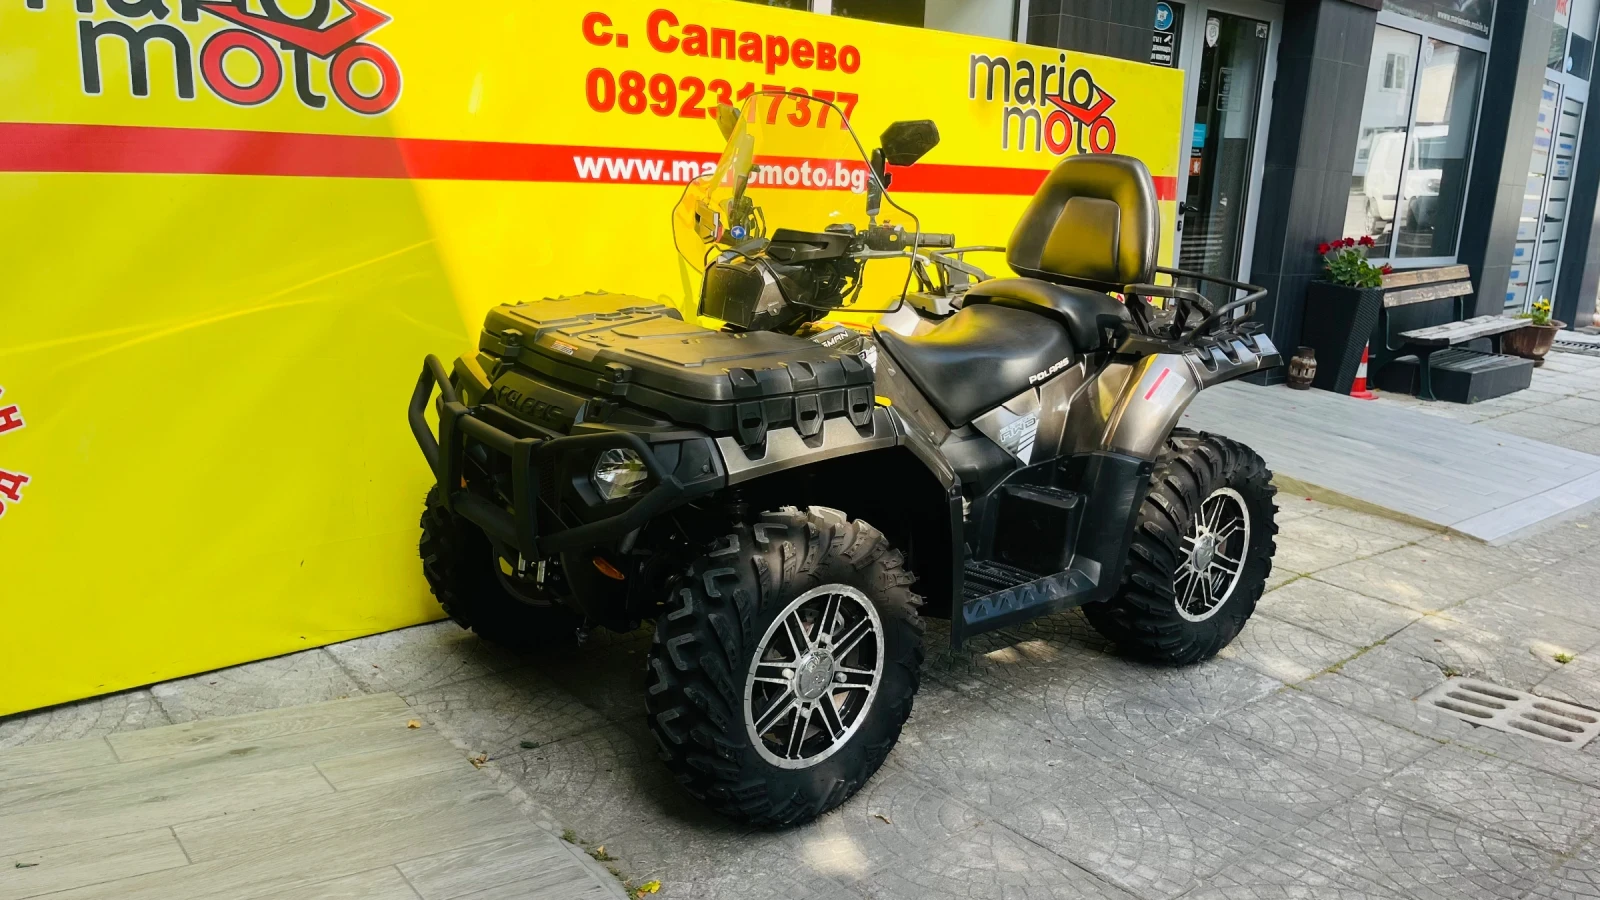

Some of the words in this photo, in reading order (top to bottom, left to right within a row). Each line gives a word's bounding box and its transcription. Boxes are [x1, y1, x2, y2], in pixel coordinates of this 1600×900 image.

[79, 20, 401, 115] moto
[583, 11, 629, 48] с.
[646, 9, 860, 74] Сапарево
[585, 67, 859, 130] 0892317377
[969, 54, 1094, 109] mario
[1003, 107, 1116, 155] moto
[573, 156, 865, 193] www.mamoto.bg
[1028, 357, 1069, 384] POLARIS
